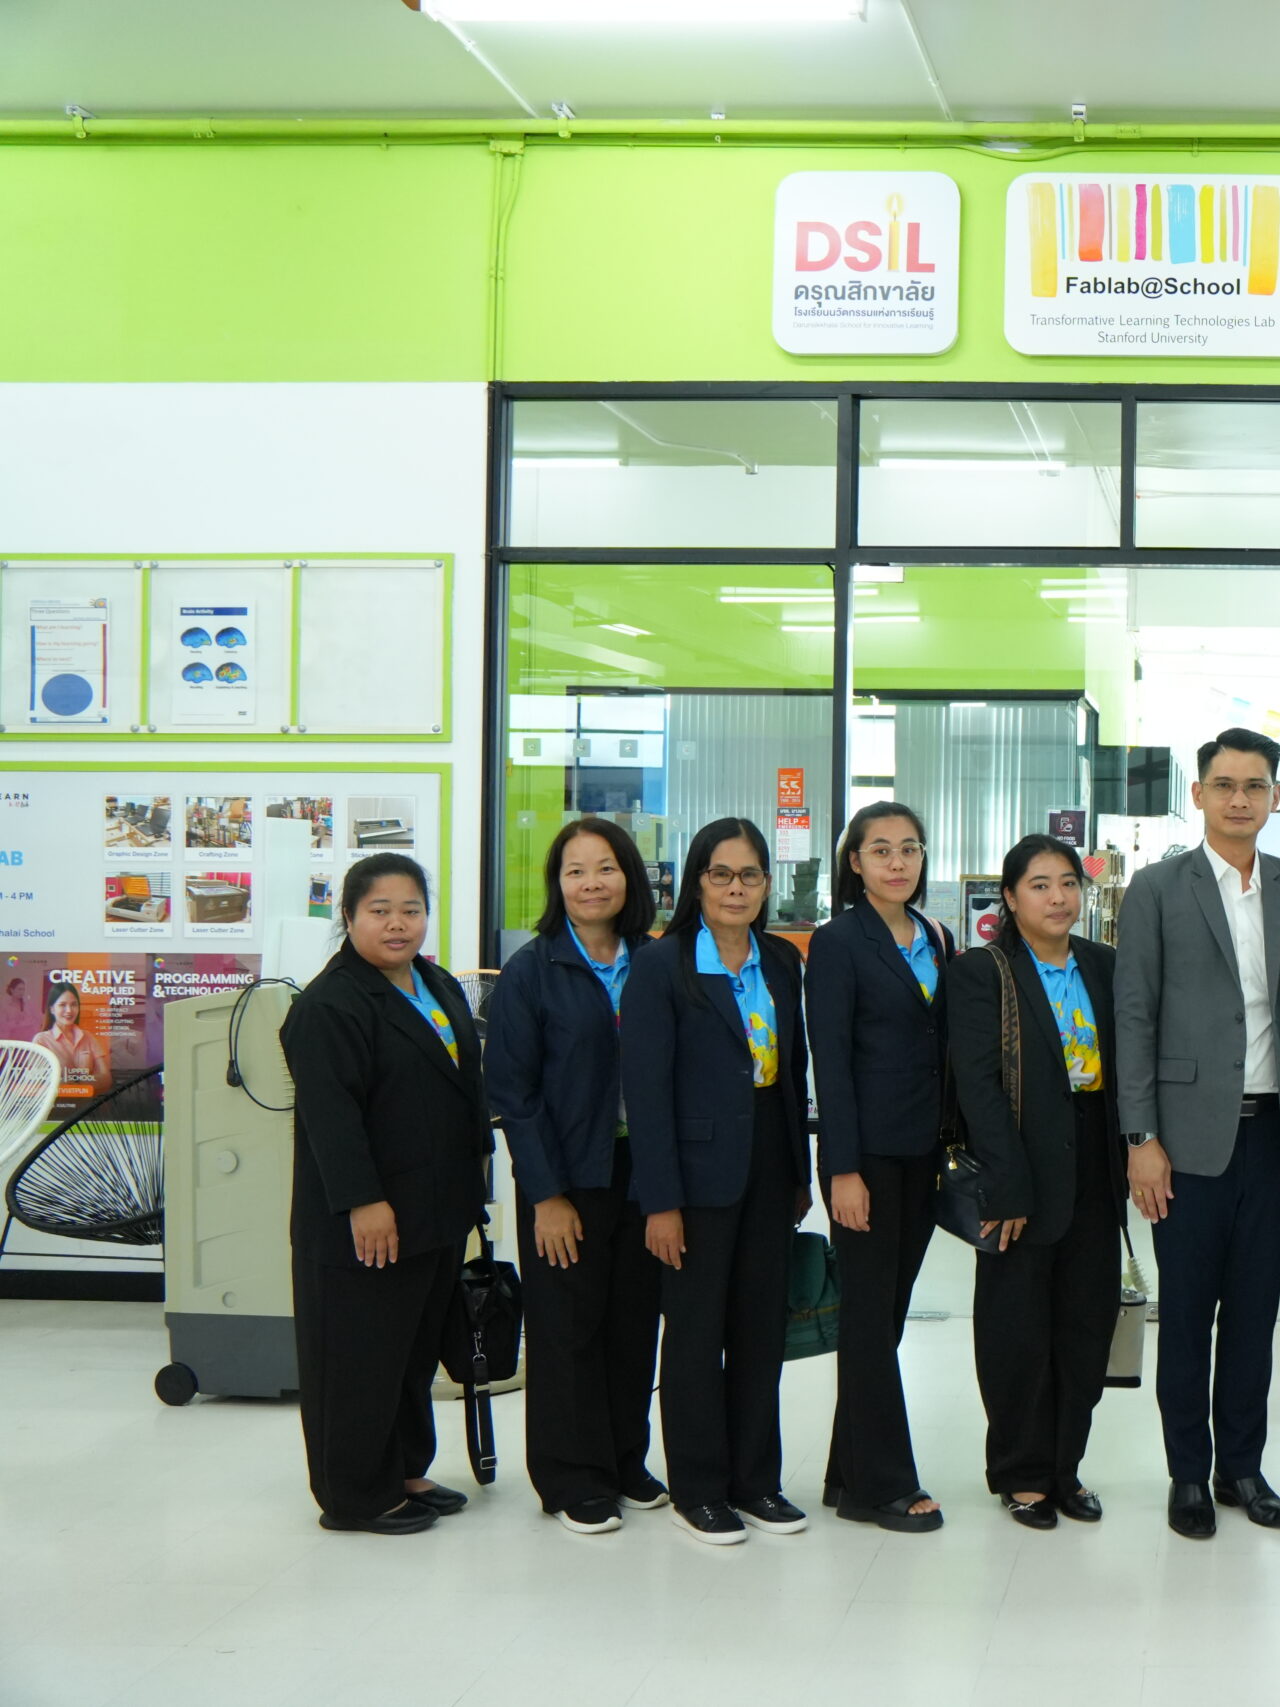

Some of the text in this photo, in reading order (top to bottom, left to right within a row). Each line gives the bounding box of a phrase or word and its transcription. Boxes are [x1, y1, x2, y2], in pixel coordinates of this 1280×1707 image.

[1065, 276, 1241, 299] Fablab@School
[794, 280, 936, 308] ดรุณสิกขาลัย
[1030, 314, 1276, 330] Transformative Learning Technologies Lab
[1097, 331, 1208, 347] Stanford University
[778, 817, 798, 825] HELP
[23, 928, 55, 938] School
[49, 969, 136, 985] CREATIVE
[154, 973, 254, 984] PROGRAMMING
[109, 997, 136, 1006] ARTS
[67, 1067, 90, 1075] UPPER
[67, 1074, 97, 1082] SCHOOL
